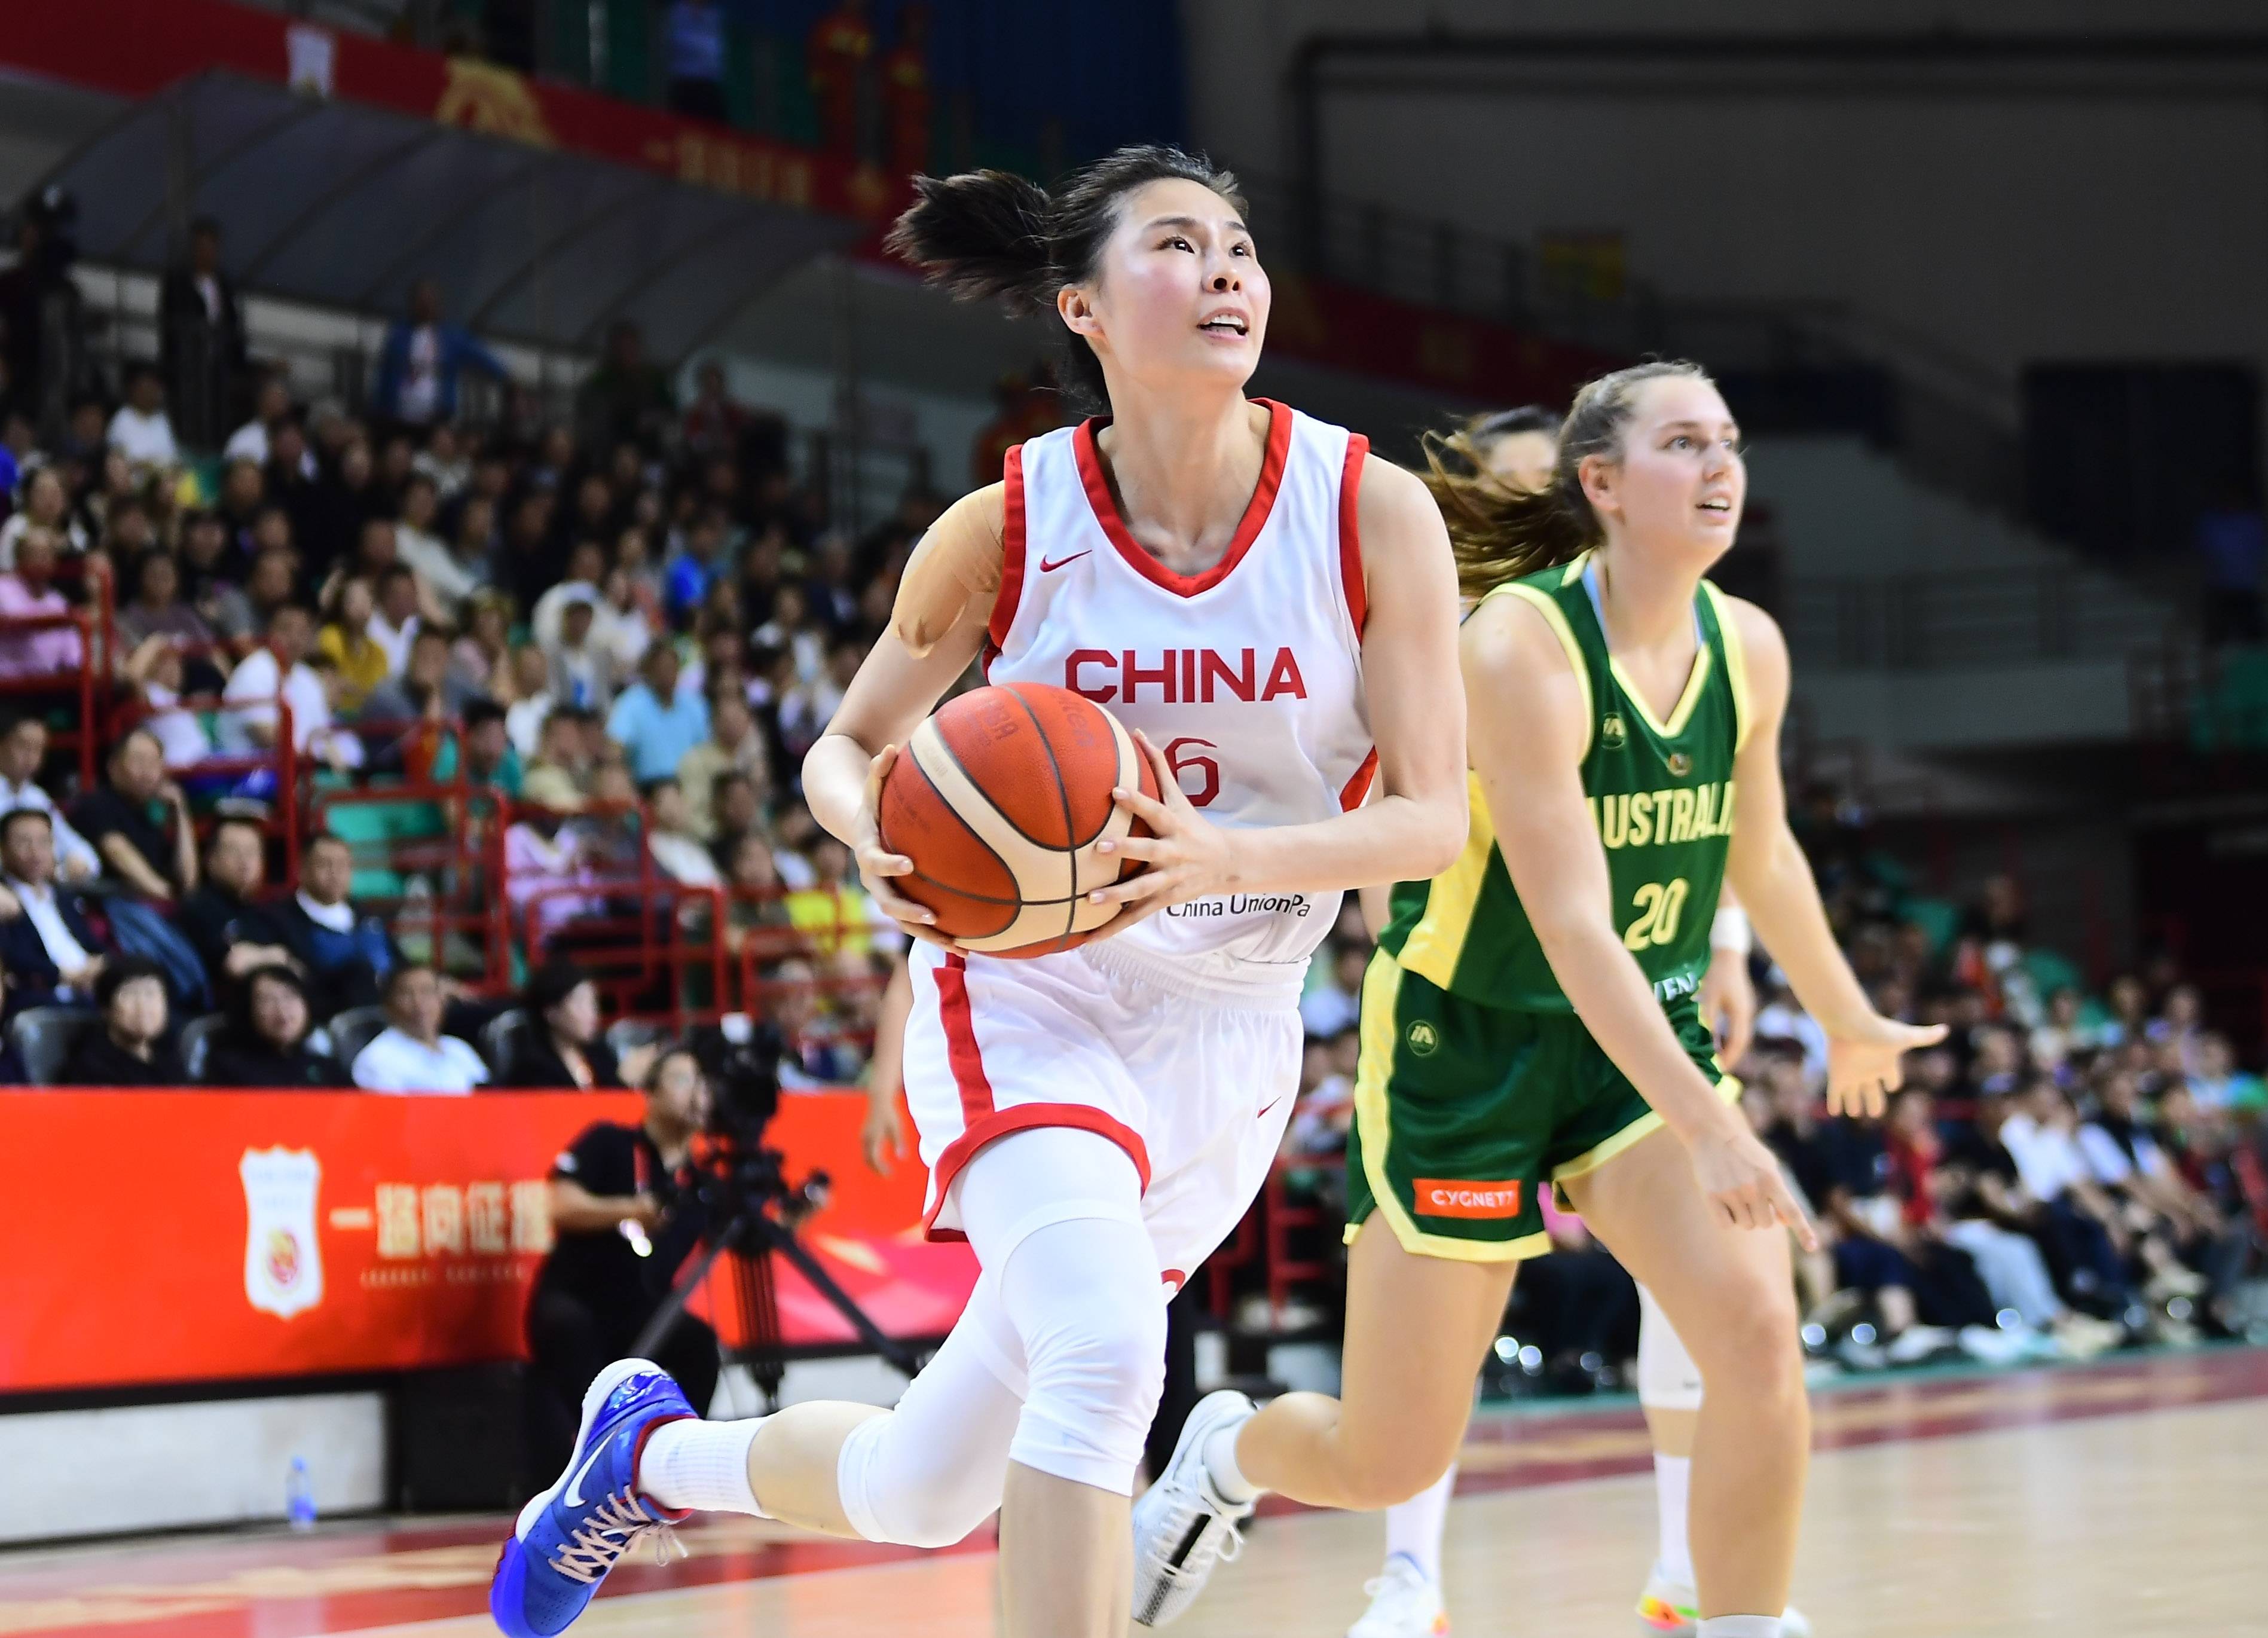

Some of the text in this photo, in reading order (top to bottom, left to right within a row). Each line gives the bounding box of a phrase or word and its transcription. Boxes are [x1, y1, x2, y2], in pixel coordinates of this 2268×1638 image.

[1065, 647, 1307, 704] CHINA
[1163, 737, 1219, 808] 6
[1588, 781, 1733, 848] USTRALI
[1624, 878, 1689, 951] 20
[1431, 1189, 1514, 1208] CYGNETT
